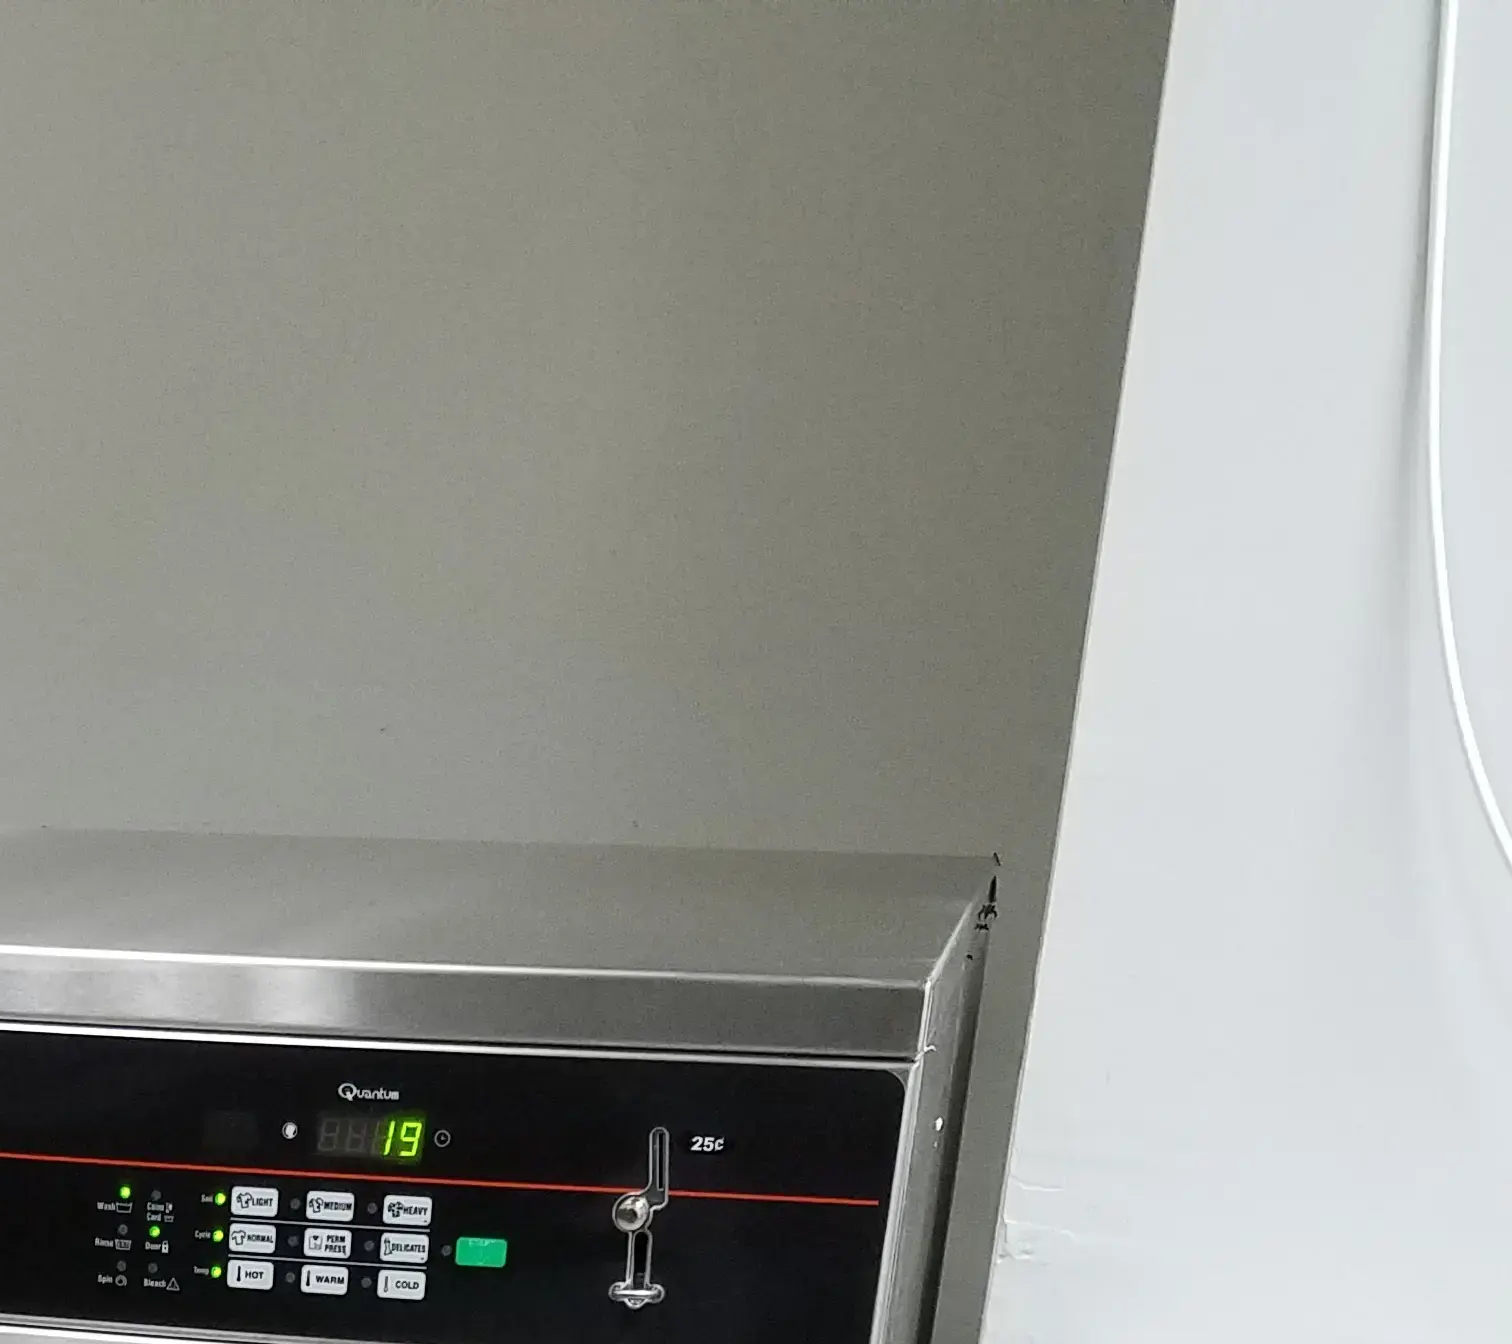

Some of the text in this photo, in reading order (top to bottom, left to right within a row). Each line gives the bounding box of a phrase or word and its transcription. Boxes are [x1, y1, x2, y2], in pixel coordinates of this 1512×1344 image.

[337, 1082, 400, 1101] Quantum
[383, 1120, 423, 1157] 19
[690, 1135, 725, 1152] 25¢
[97, 1202, 116, 1210] Wash
[252, 1198, 273, 1207] LIGHT
[324, 1201, 352, 1211] MEDIUM
[403, 1206, 428, 1215] HEAVY
[146, 1212, 161, 1221] Card
[194, 1230, 211, 1239] Cycle
[247, 1234, 274, 1243] NORMAL
[326, 1235, 346, 1243] PERM
[324, 1244, 346, 1254] PRESS
[391, 1243, 426, 1253] DELICATES
[97, 1274, 113, 1284] Spin
[245, 1270, 264, 1279] HOT
[143, 1278, 166, 1288] Bleach
[315, 1275, 345, 1285] WARM
[395, 1280, 420, 1290] COLD
